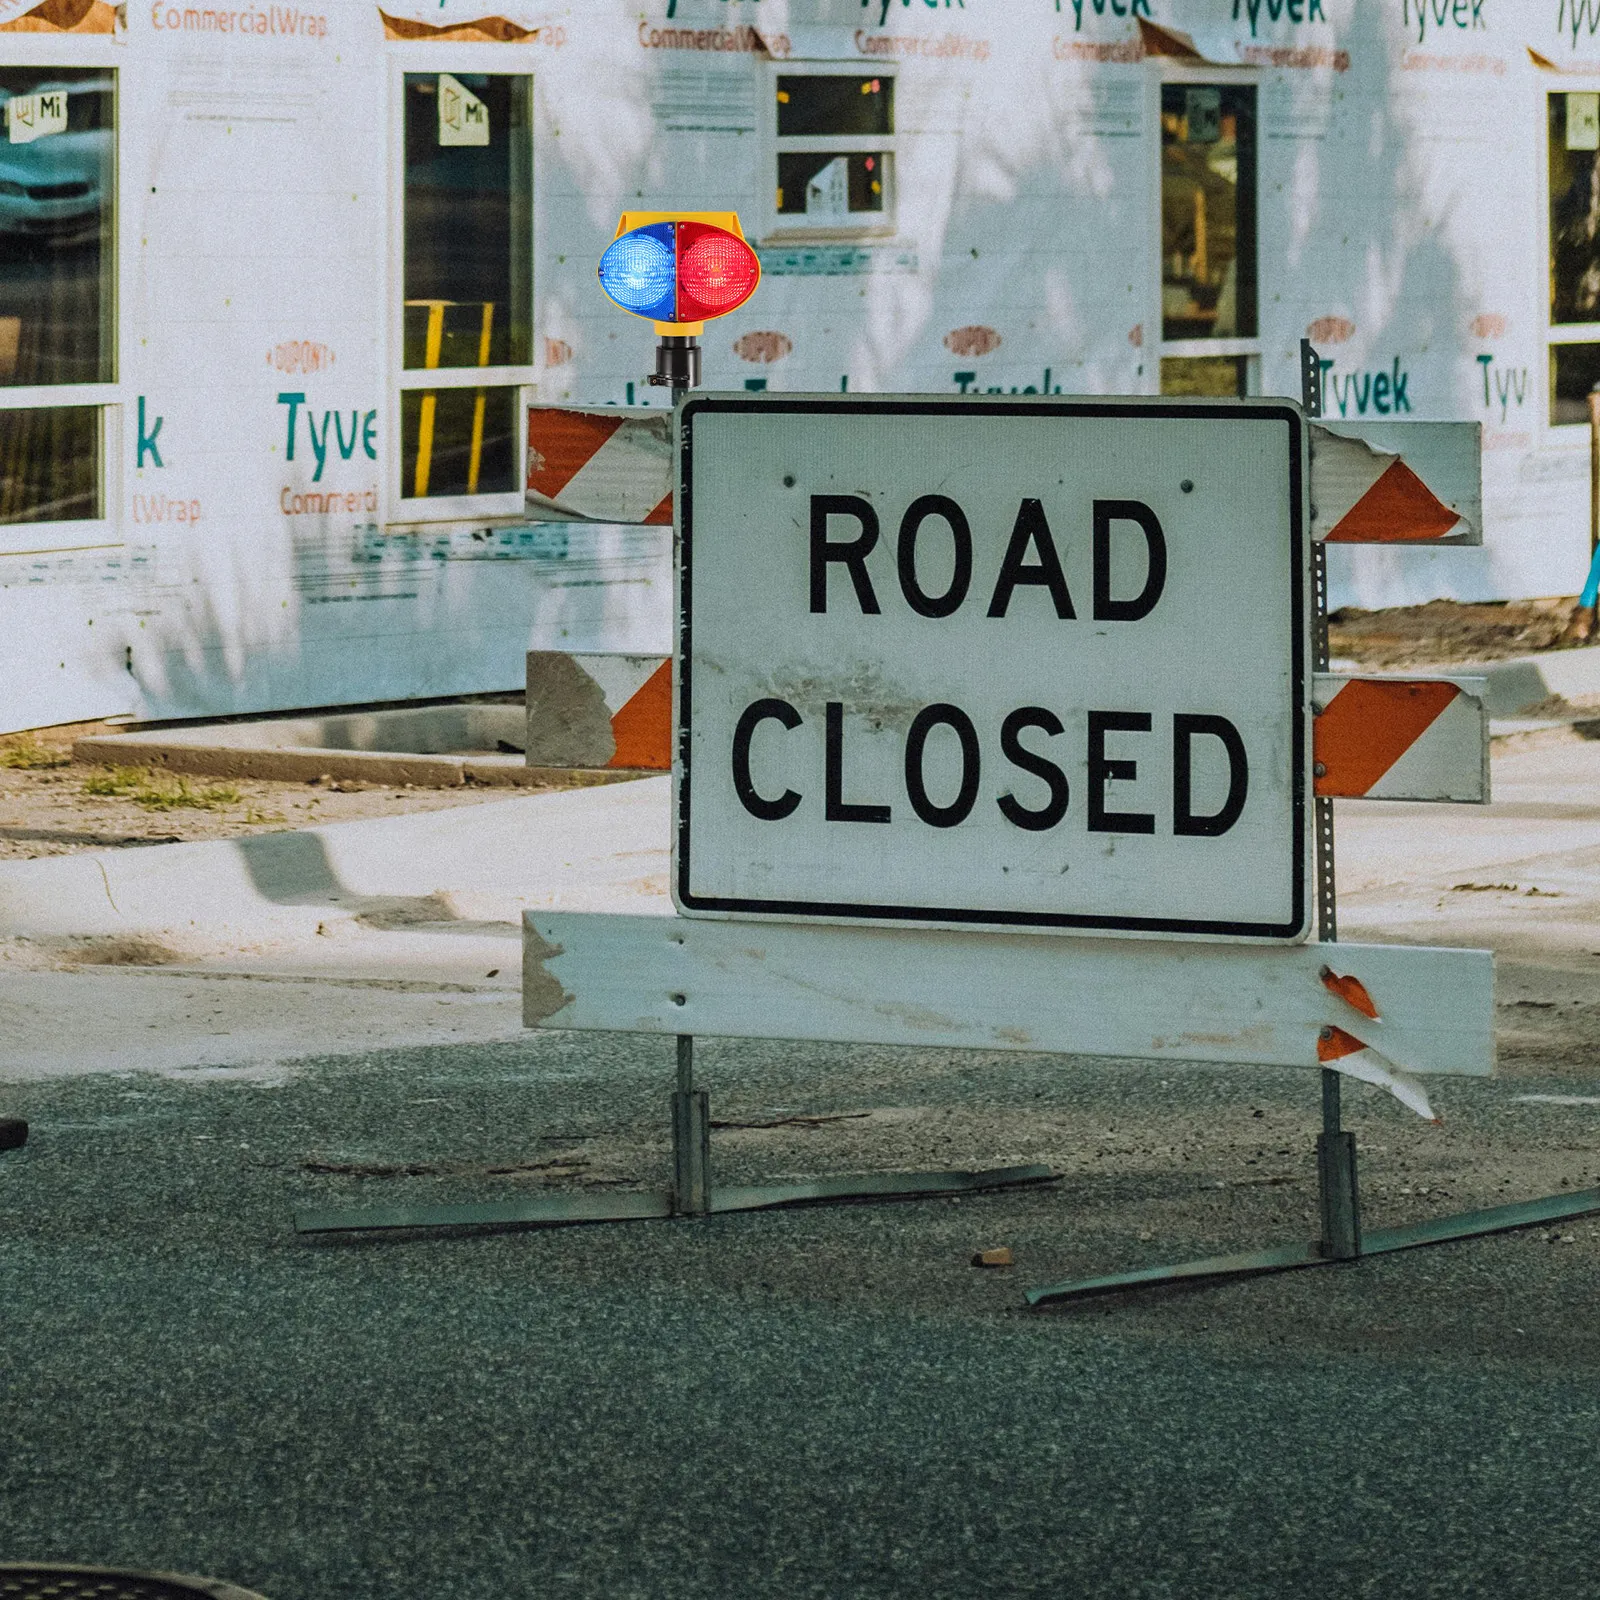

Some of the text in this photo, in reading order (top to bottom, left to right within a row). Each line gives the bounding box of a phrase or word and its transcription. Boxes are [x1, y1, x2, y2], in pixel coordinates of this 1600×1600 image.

[151, 1, 328, 39] CommercialWrap
[41, 96, 60, 118] Mi
[277, 392, 377, 482] Tyve
[809, 494, 1167, 622] ROAD
[732, 697, 1249, 837] CLOSED
